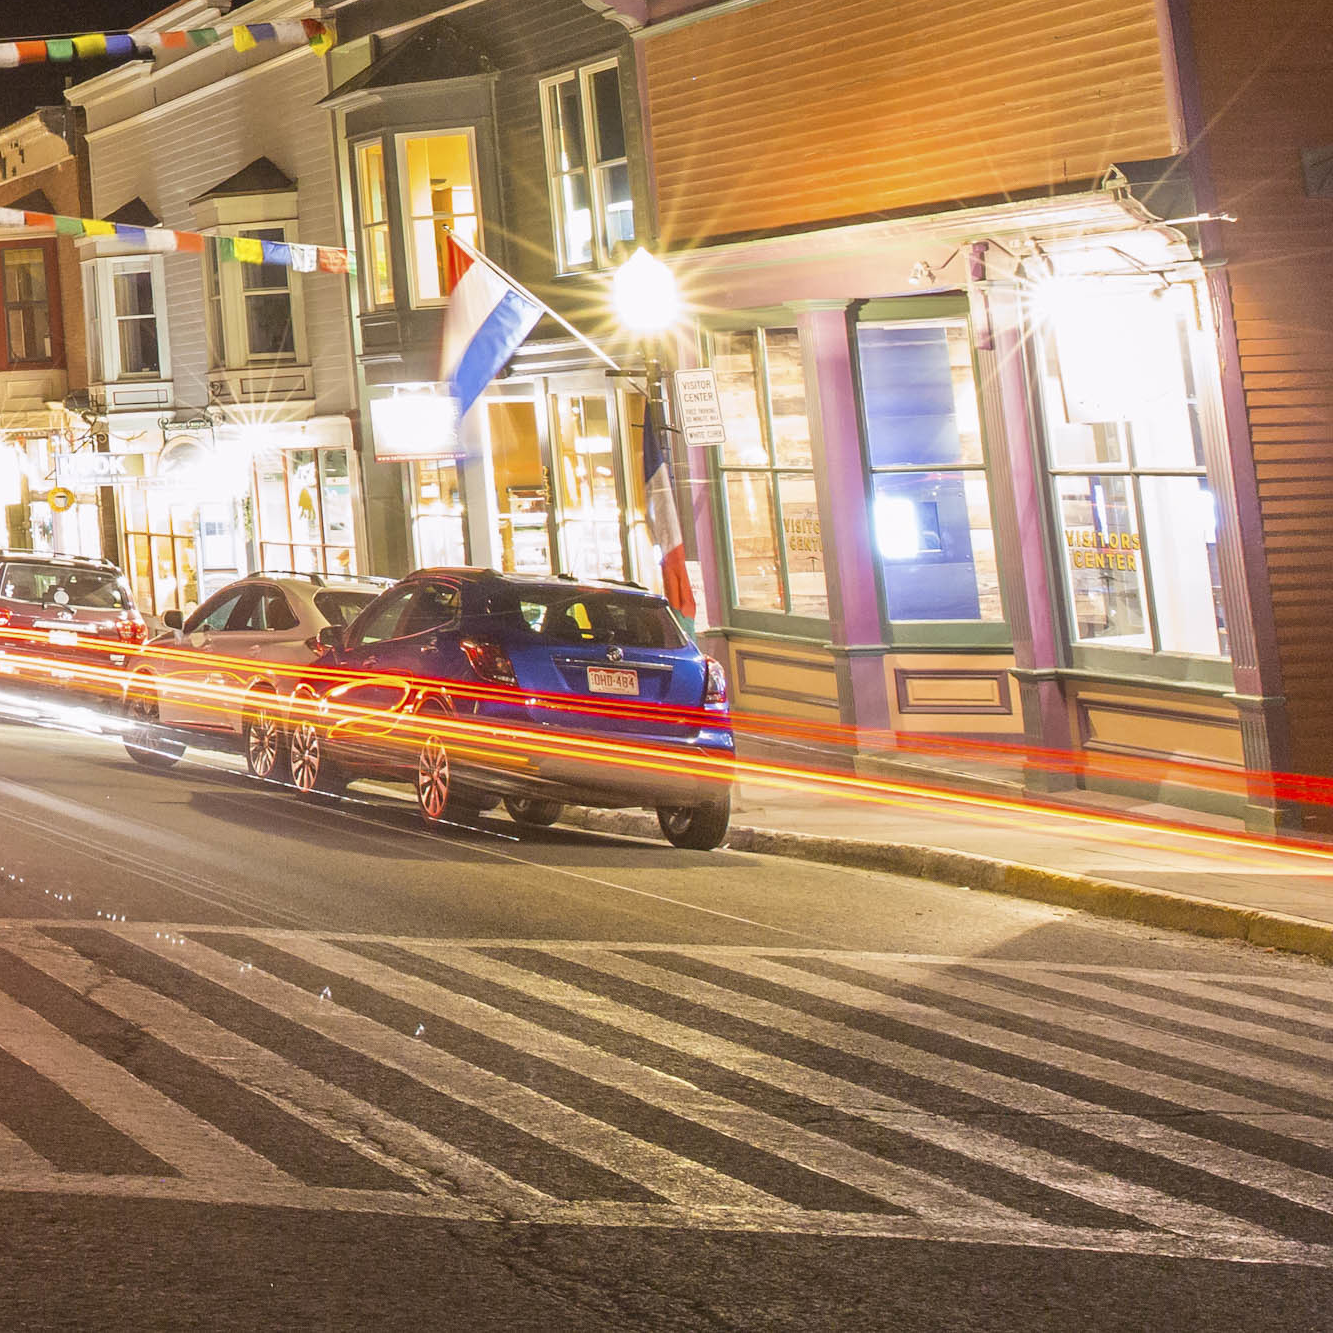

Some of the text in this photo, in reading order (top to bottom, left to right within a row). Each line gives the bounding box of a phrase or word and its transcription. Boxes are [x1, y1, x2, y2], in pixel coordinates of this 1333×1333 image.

[682, 379, 712, 390] VISITOR
[684, 393, 714, 403] CENTER
[1065, 530, 1141, 550] VISITORS
[1074, 551, 1137, 571] CENTER
